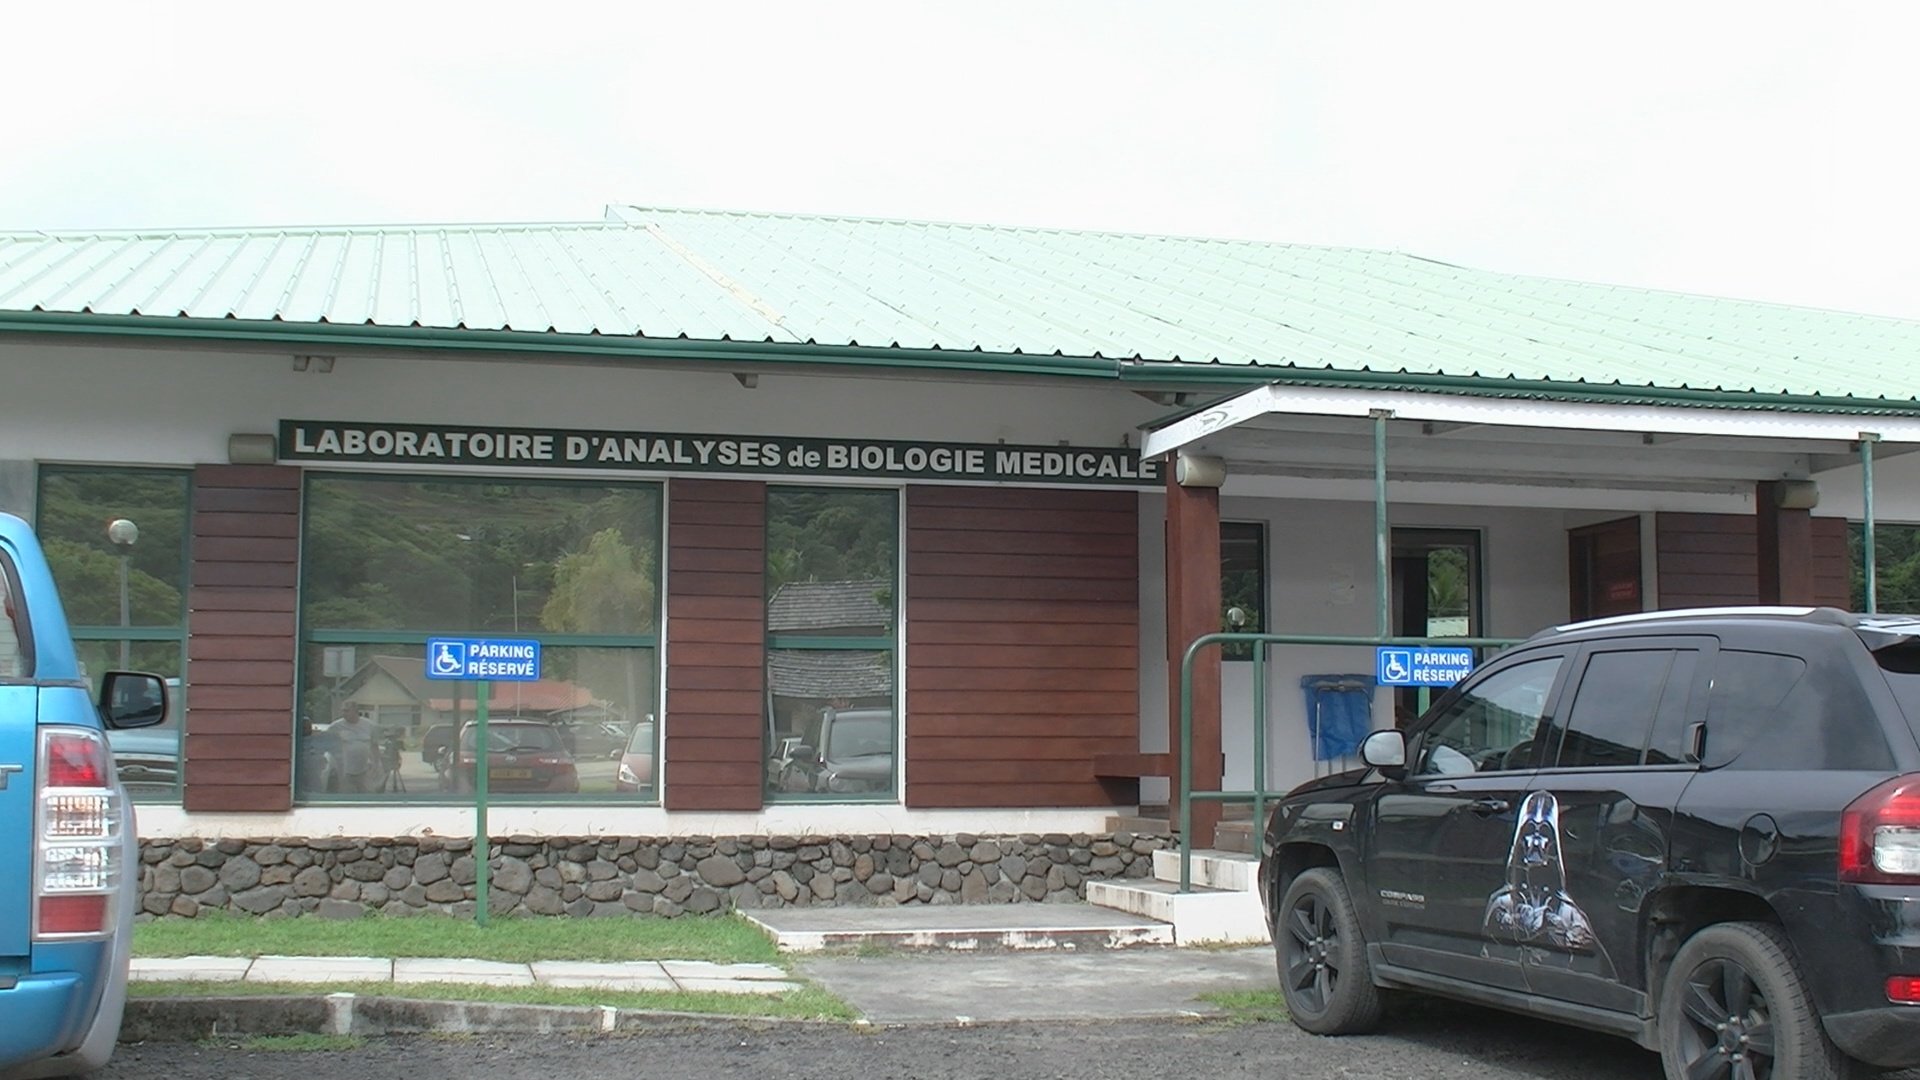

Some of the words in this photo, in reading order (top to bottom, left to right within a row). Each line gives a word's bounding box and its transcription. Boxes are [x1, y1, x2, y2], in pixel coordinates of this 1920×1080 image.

[294, 428, 553, 460] LABORATOIRE
[566, 437, 781, 467] D'ANALYSES
[787, 445, 821, 469] de
[827, 445, 985, 474] BIOLOGIE
[995, 451, 1158, 479] MEDICALE
[470, 645, 534, 658] PARKING
[1414, 653, 1469, 665] PARKING
[469, 659, 534, 675] RÉSERVÉ
